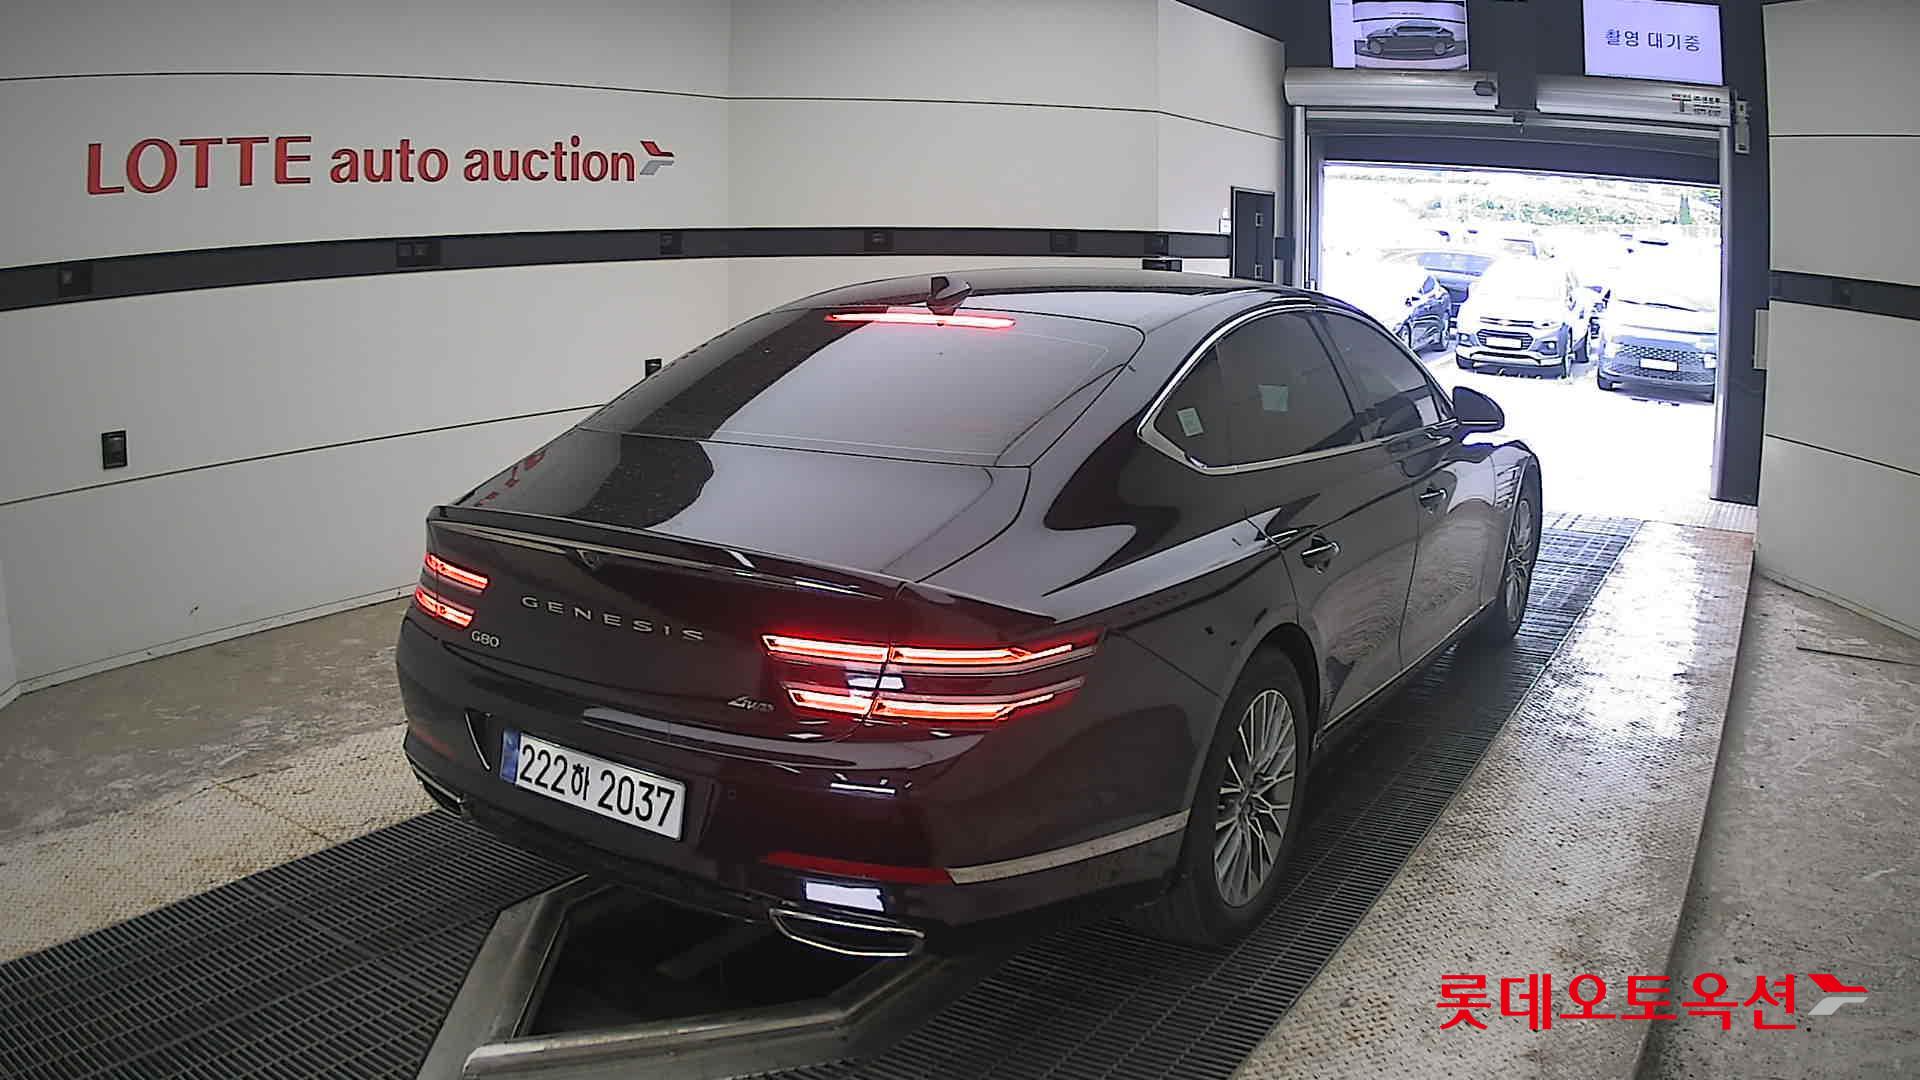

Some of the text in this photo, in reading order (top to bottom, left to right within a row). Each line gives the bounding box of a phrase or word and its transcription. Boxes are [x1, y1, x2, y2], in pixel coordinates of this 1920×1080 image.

[1606, 29, 1700, 52] 촬영 대기중
[87, 135, 636, 195] LOTTE auto auction
[471, 630, 500, 647] G80
[521, 596, 704, 640] GENESIS
[519, 744, 676, 827] 222하 2037
